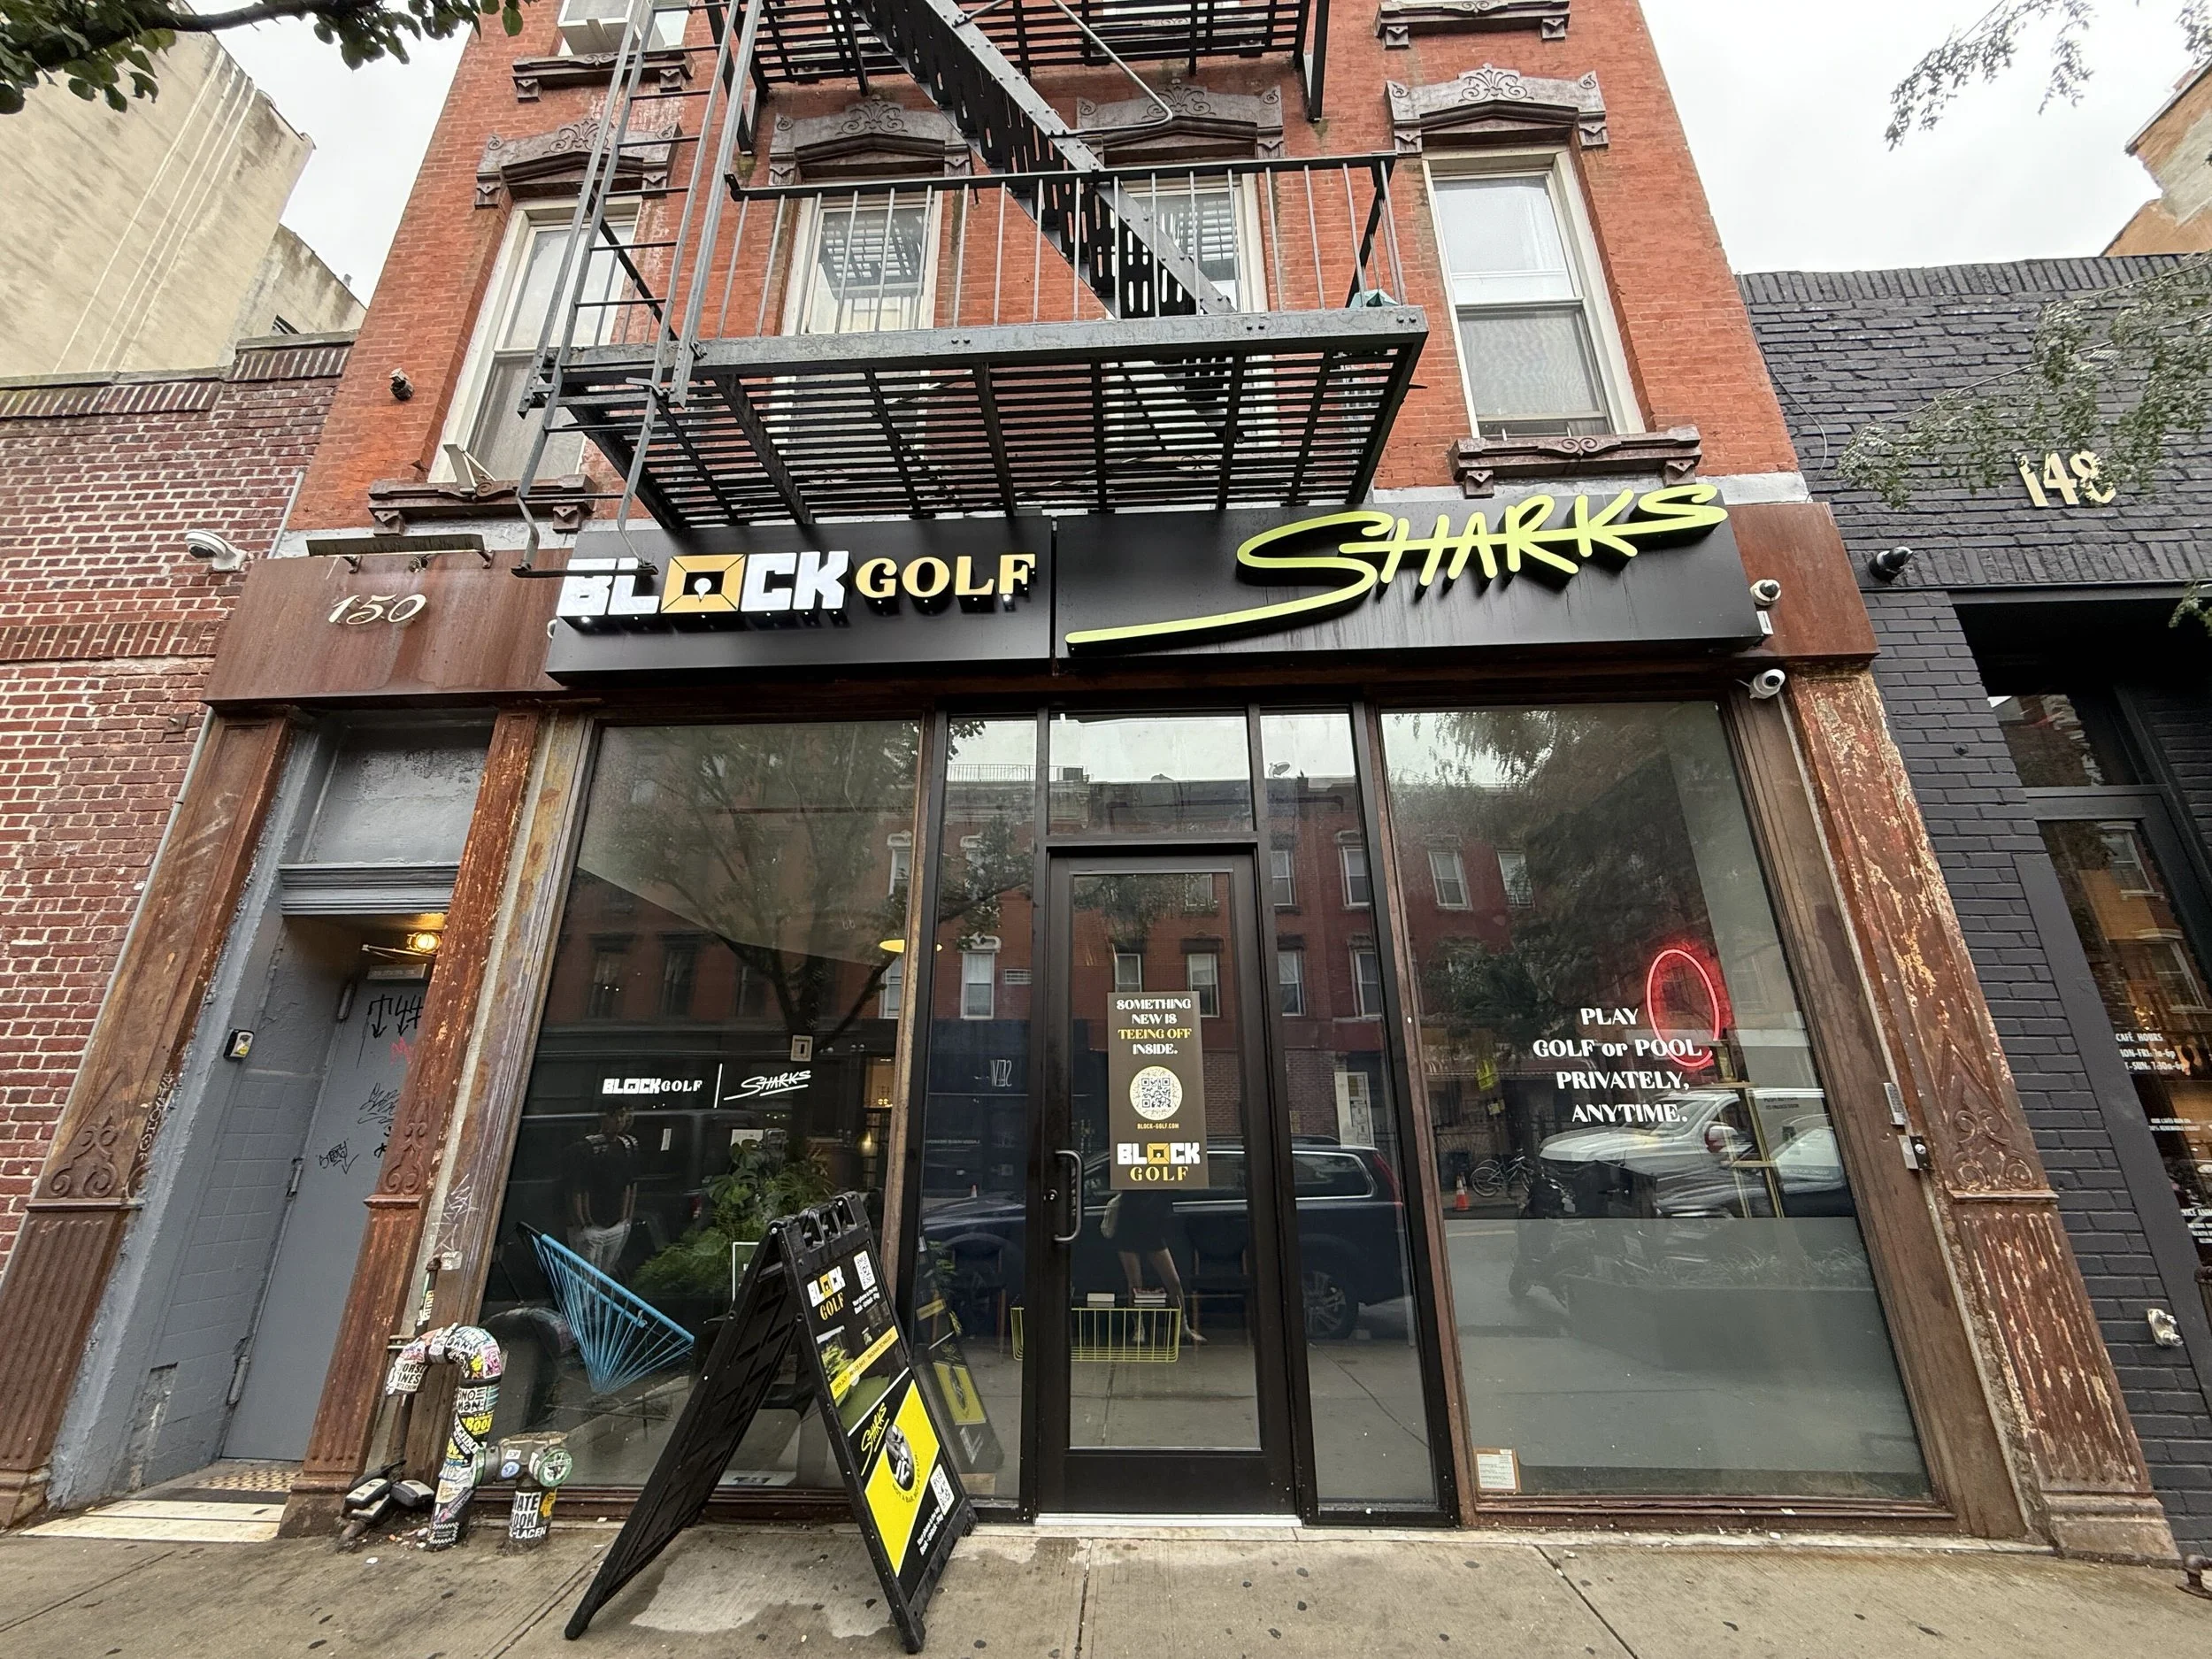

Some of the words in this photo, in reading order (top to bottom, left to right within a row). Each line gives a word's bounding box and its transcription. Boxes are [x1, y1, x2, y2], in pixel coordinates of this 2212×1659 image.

[2013, 449, 2117, 507] 148
[1064, 483, 1728, 644] SHARKS
[556, 550, 849, 617] BLOCK
[855, 552, 1037, 602] GOLF
[328, 593, 426, 625] 150
[1116, 998, 1192, 1010] SOMETHING
[1131, 1013, 1163, 1025] NEW
[1164, 1013, 1178, 1025] IS
[1580, 1008, 1638, 1025] PLAY
[1118, 1028, 1165, 1040] TEEING
[1167, 1028, 1193, 1039] OFF
[2136, 1033, 2164, 1042] HOURS
[1132, 1043, 1179, 1055] INSIDE.
[1532, 1039, 1595, 1057] GOLF
[1601, 1044, 1628, 1057] or
[1634, 1039, 1701, 1056] POOL
[602, 1078, 662, 1094] BLOCK
[661, 1079, 703, 1093] GOLF
[723, 1070, 811, 1101] SHARKS
[1556, 1071, 1690, 1091] PRIVATELY,
[1571, 1103, 1688, 1123] ANYTIME.
[1117, 1142, 1201, 1165] BLOCK
[1130, 1166, 1189, 1181] GOLF
[806, 1265, 846, 1308] BLOCK
[819, 1292, 844, 1320] GOLF
[861, 1402, 887, 1476] SHARKS
